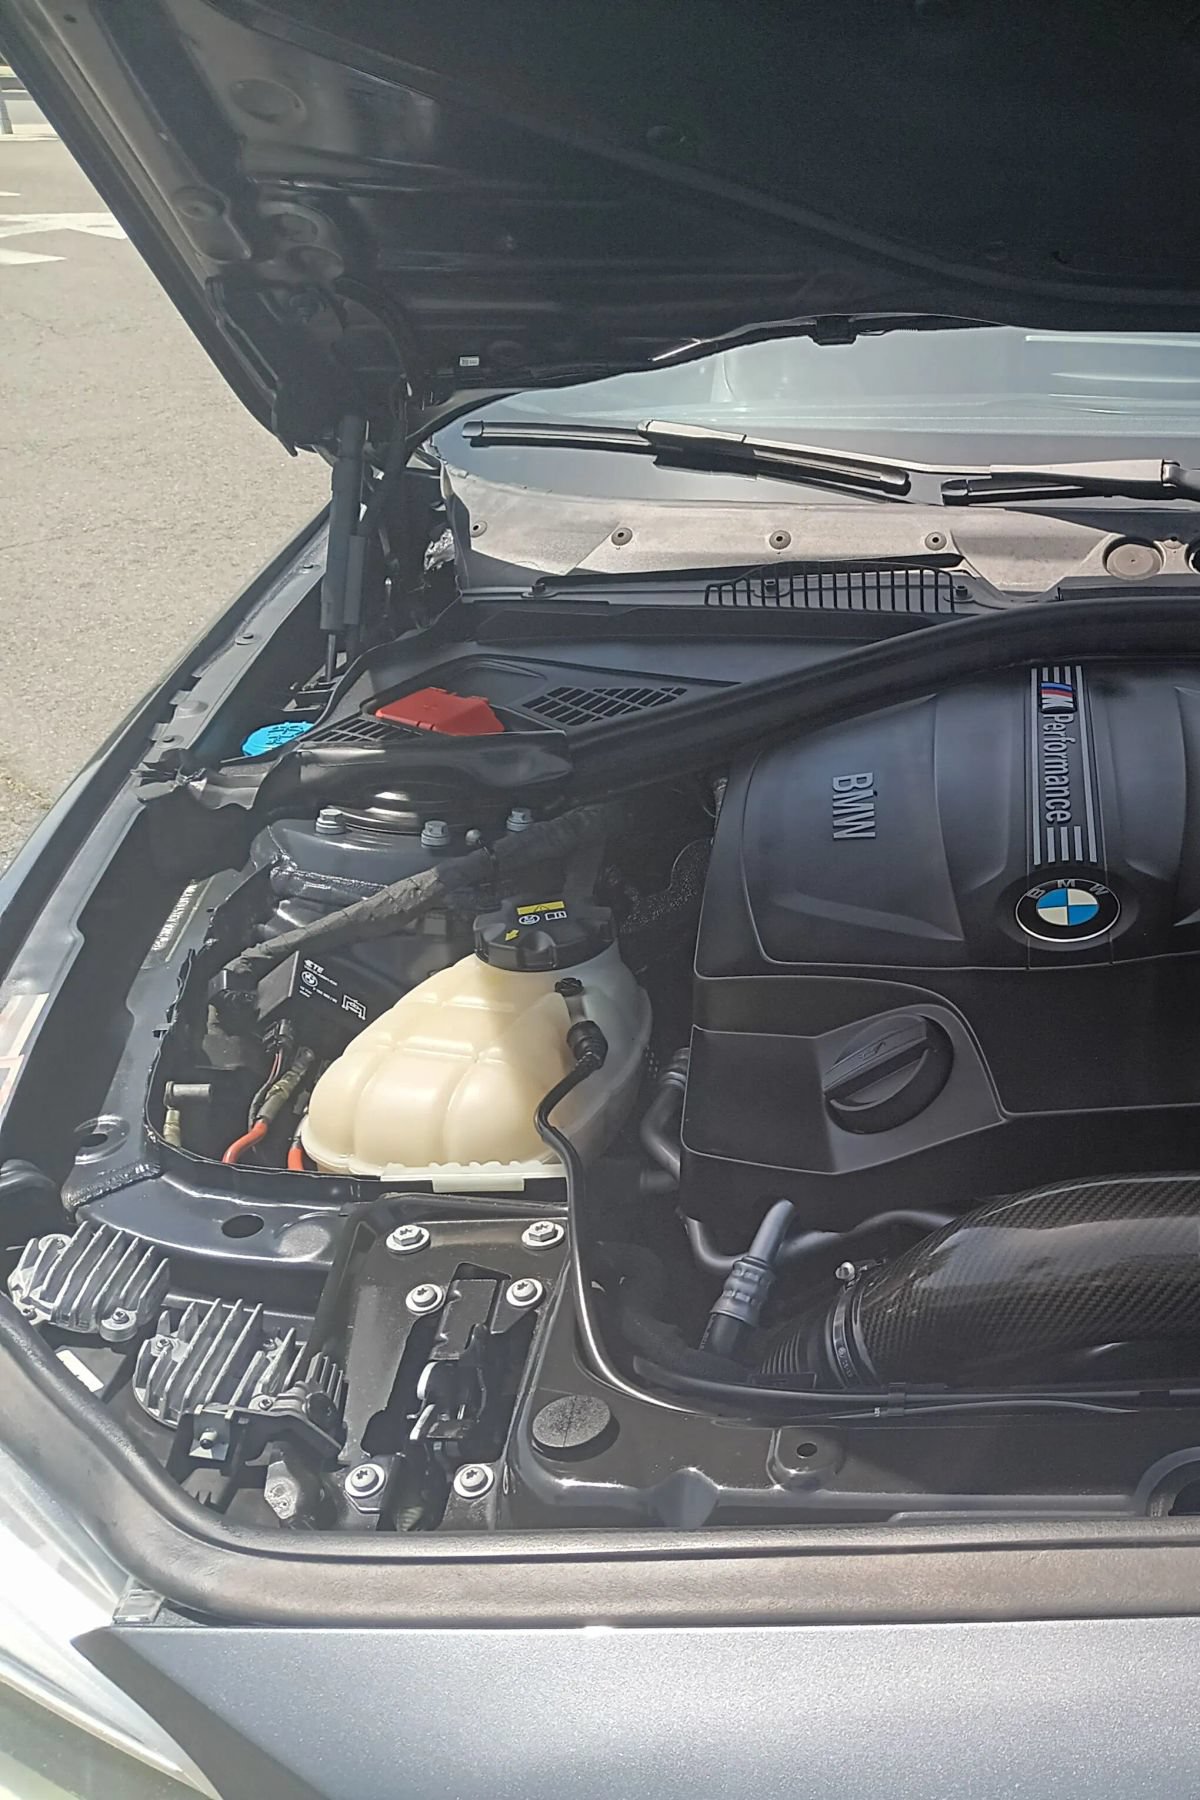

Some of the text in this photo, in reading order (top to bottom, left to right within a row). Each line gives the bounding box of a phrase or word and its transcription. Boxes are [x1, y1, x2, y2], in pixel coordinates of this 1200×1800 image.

[1043, 713, 1075, 823] Performance
[832, 772, 876, 839] BMW
[1026, 879, 1109, 899] BMW
